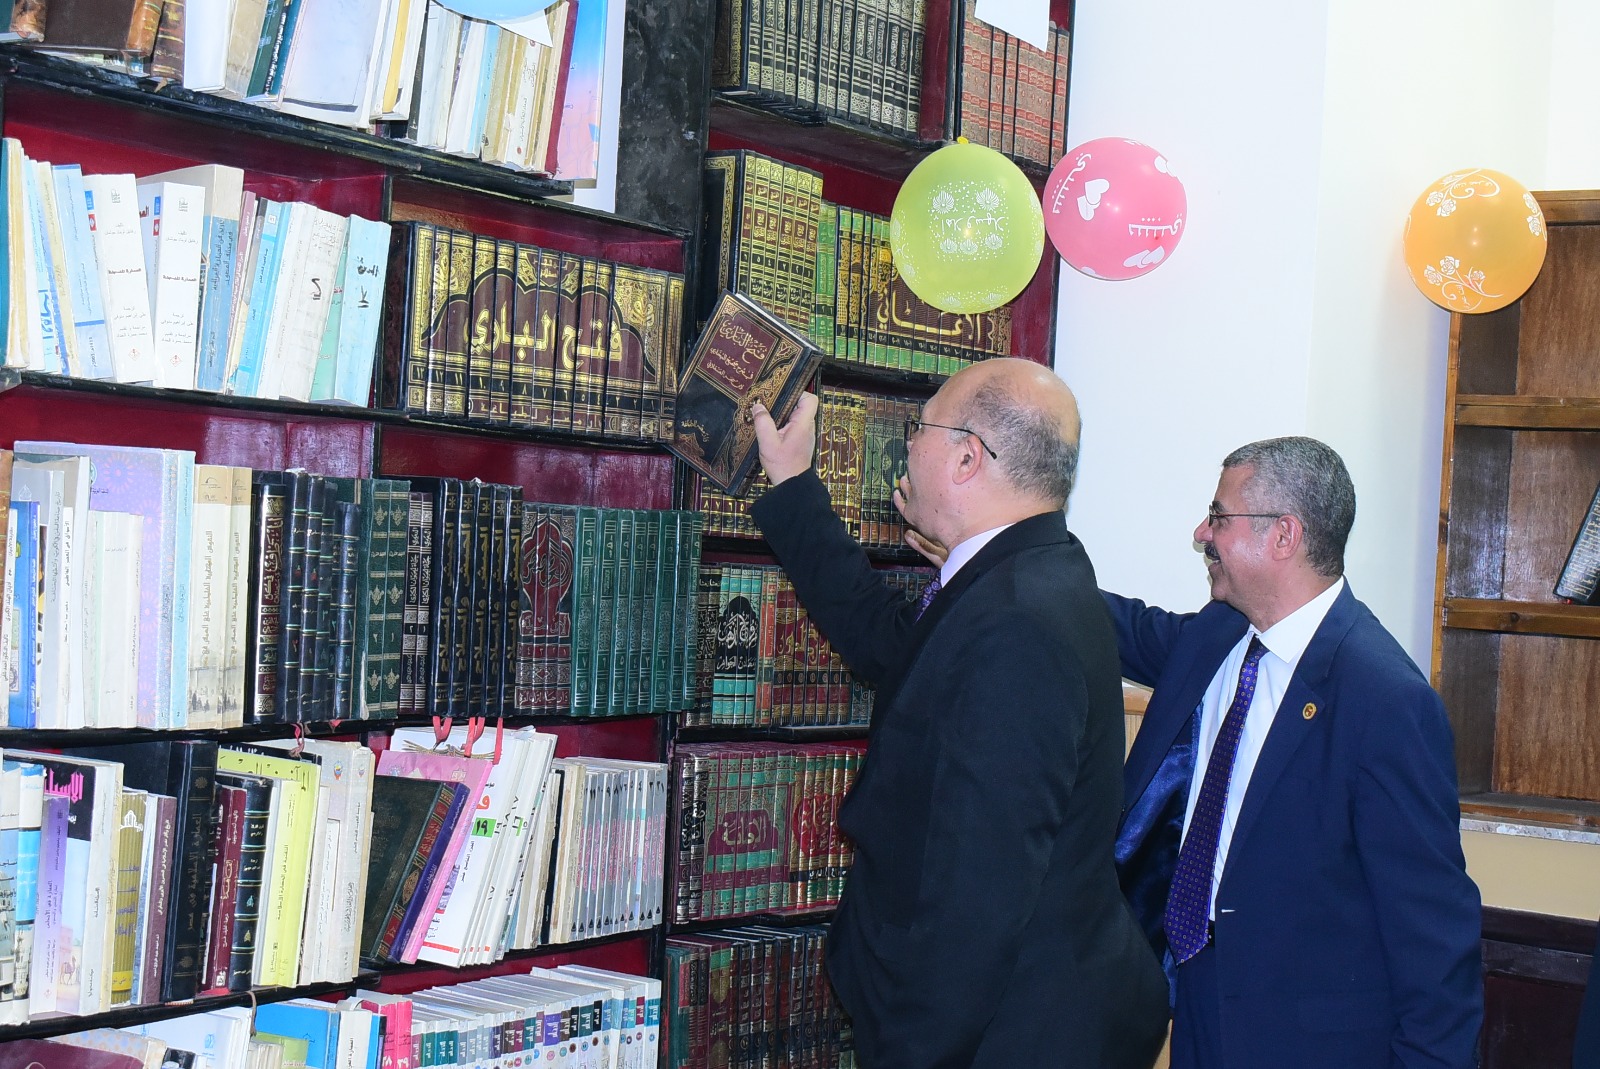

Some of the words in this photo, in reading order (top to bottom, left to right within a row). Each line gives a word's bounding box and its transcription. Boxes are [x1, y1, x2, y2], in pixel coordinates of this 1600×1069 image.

[464, 301, 557, 361] الباري
[562, 317, 623, 371] فتح
[454, 370, 463, 386] ١١
[521, 384, 528, 395] ٨
[541, 387, 548, 399] ٧
[476, 819, 488, 836] ١٩
